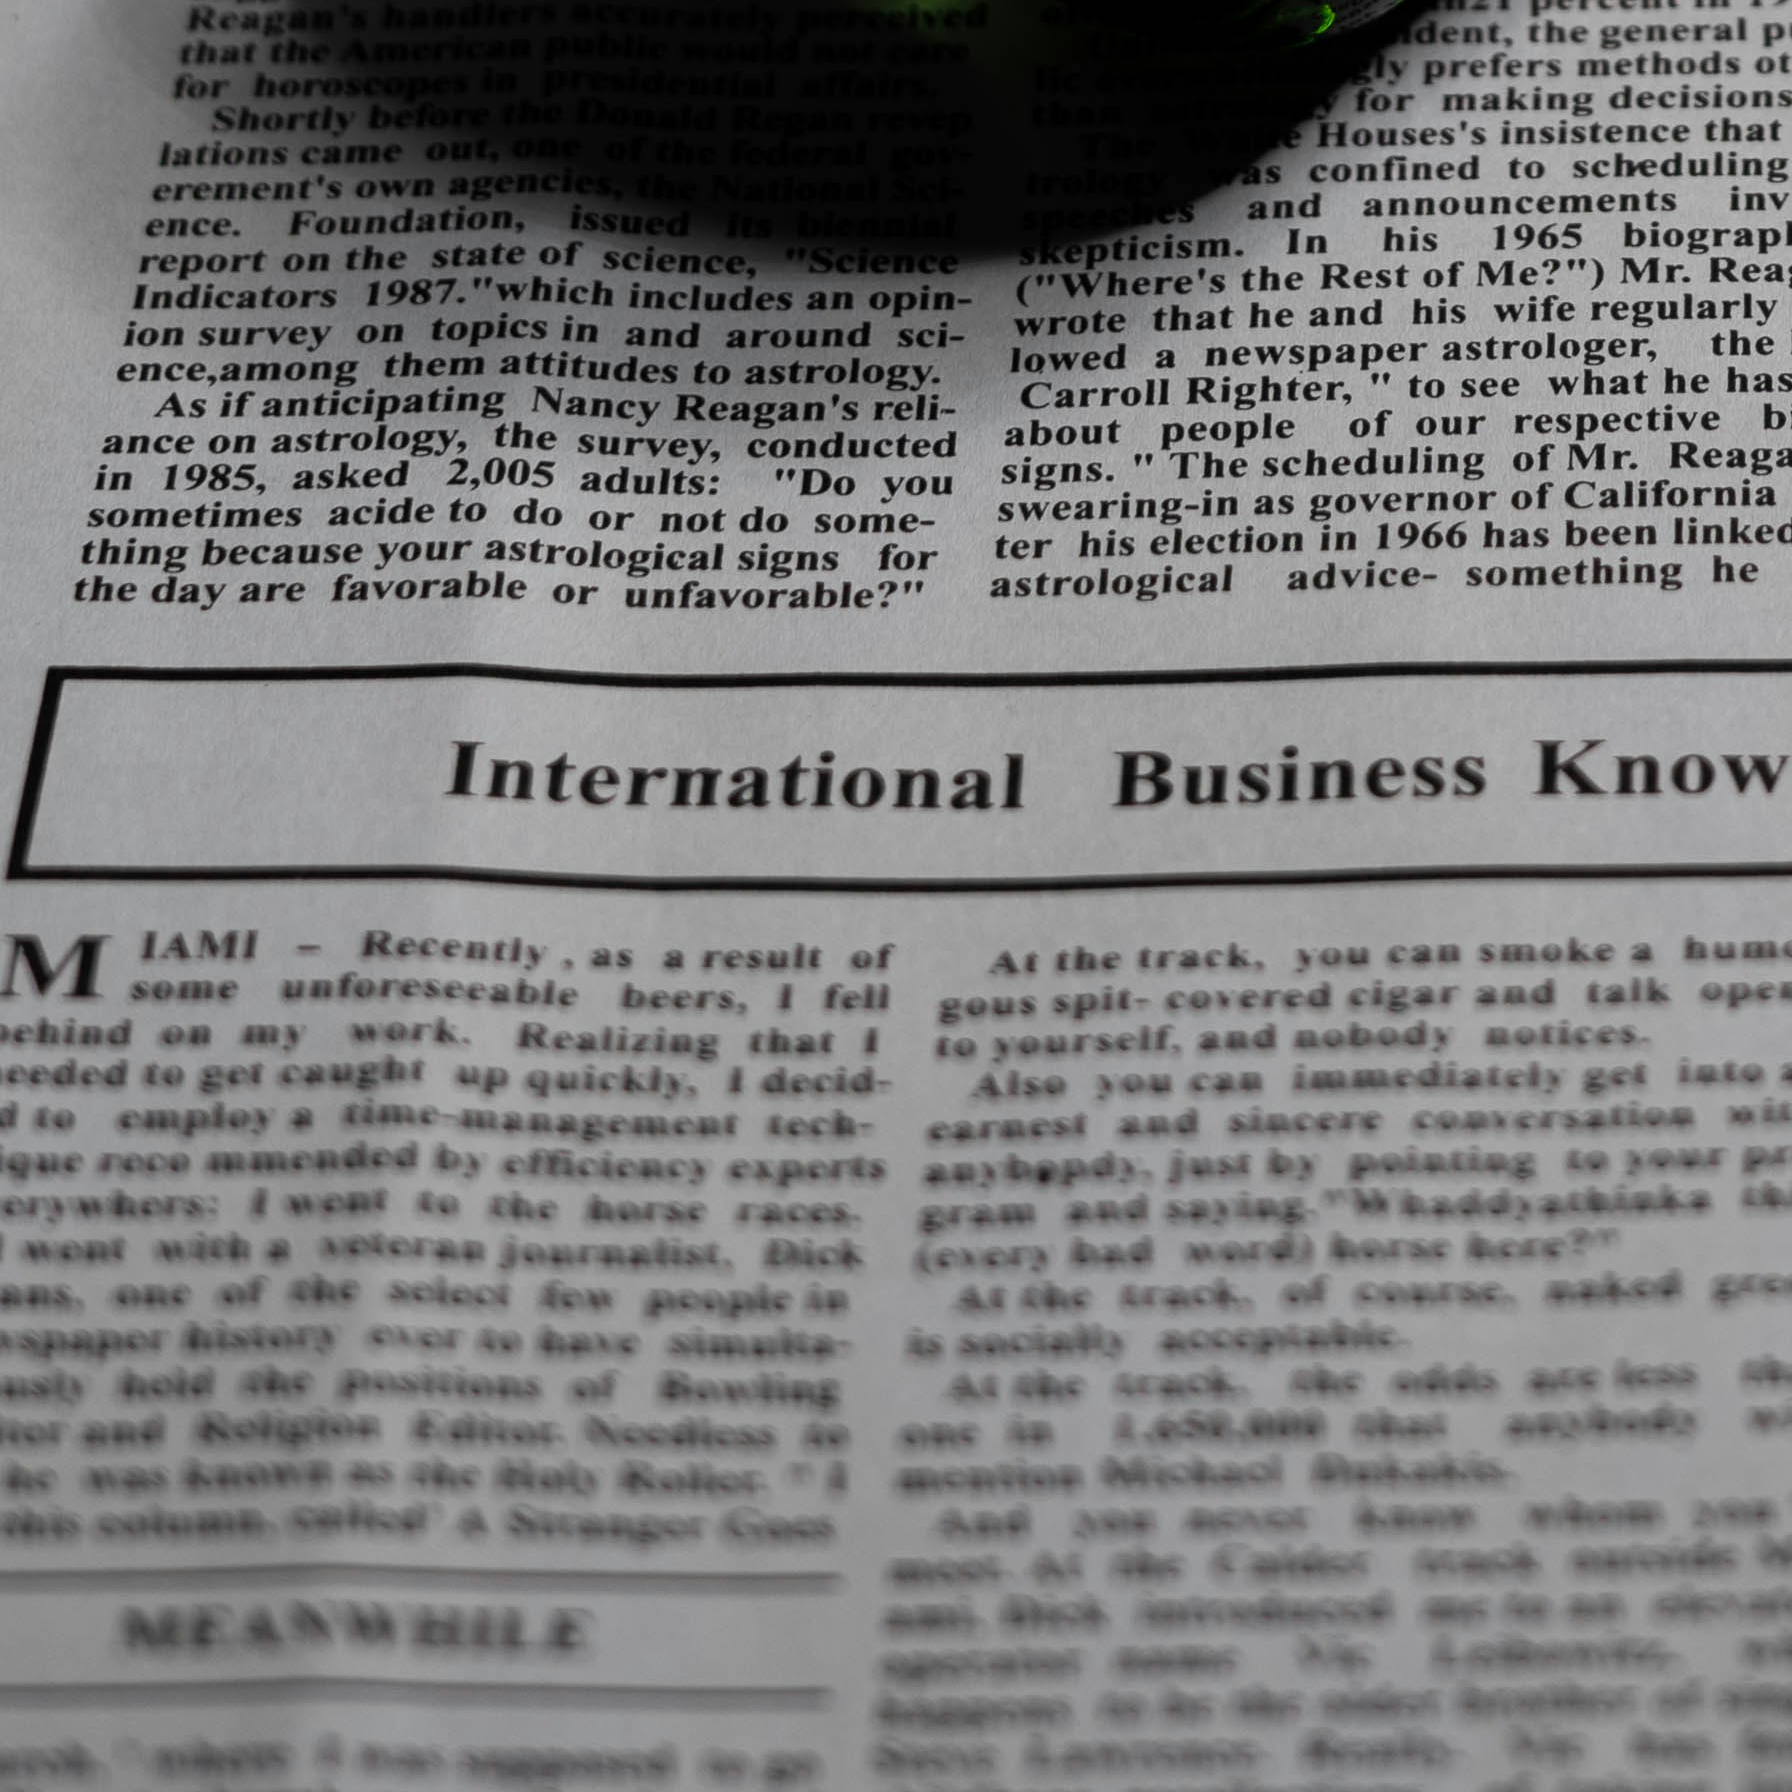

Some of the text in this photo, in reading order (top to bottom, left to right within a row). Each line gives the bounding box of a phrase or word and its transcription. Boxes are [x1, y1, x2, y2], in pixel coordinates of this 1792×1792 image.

[1016, 263, 1228, 299] ("Where's
[1241, 265, 1304, 293] the
[1320, 263, 1409, 290] Rest
[1422, 260, 1465, 288] of
[1476, 258, 1605, 291] Me?")
[1620, 257, 1691, 284] Mr.
[101, 421, 957, 466] ance on astrology, the survey, conducted
[94, 456, 953, 504] in 1985, asked 2,005 adults: "Do you
[997, 489, 1238, 526] swearing-in
[1253, 494, 1295, 516] as
[1309, 490, 1497, 523] governor
[1510, 481, 1555, 511] of
[1564, 478, 1777, 510] California
[81, 537, 939, 579] thing because your astrological signs for
[995, 534, 1053, 560] ter
[1078, 529, 1135, 558] his
[1149, 525, 1304, 556] election
[1320, 523, 1357, 552] in
[1377, 520, 1468, 550] 1966
[1482, 520, 1550, 549] has
[1565, 519, 1657, 547] been
[73, 570, 924, 611] the day are favorable or unfavorable?"
[988, 563, 1236, 601] astrological
[1286, 558, 1440, 593] advice-
[1464, 555, 1686, 593] something
[1712, 555, 1760, 583] he
[445, 739, 1024, 811] International
[1112, 749, 1487, 808] Business
